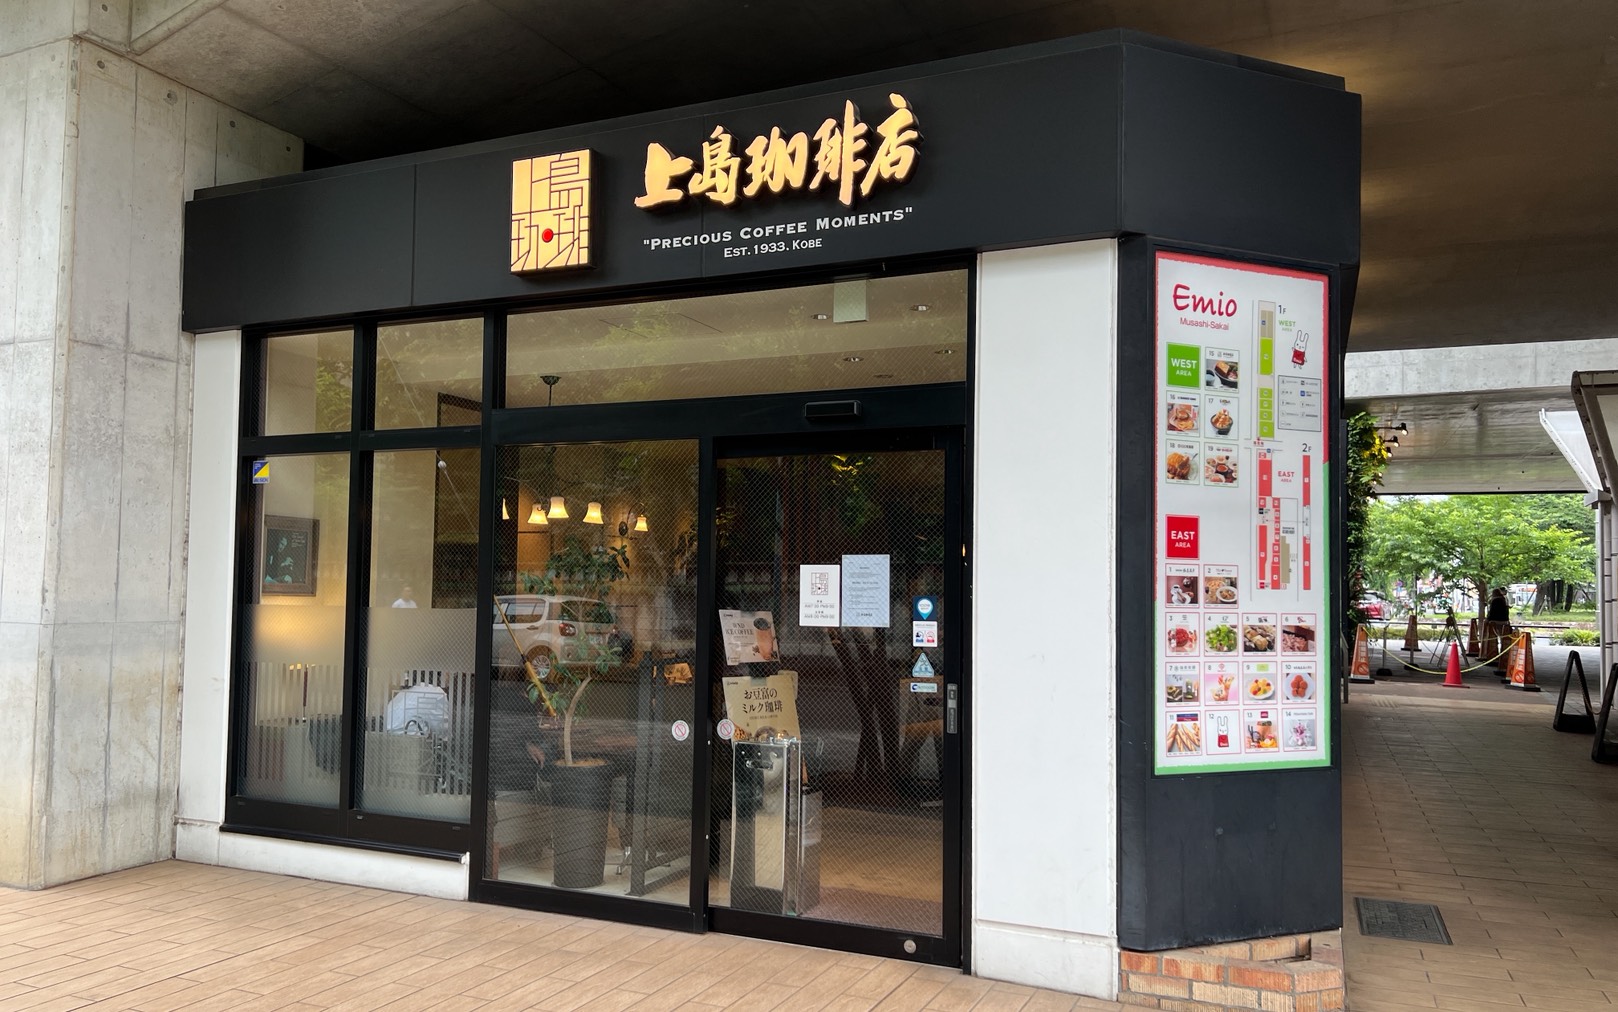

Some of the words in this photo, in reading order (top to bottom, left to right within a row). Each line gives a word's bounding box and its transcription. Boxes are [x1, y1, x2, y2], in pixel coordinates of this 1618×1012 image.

[634, 92, 919, 207] 上島珈琲店
[739, 221, 808, 240] COFFEE
[1172, 283, 1238, 318] Emio
[1179, 317, 1230, 331] Musashi-Sakai
[1278, 319, 1297, 327] WEST
[1170, 357, 1198, 370] WEST
[1175, 369, 1192, 377] AREA
[1277, 470, 1295, 478] EAST
[1170, 530, 1196, 541] EAST
[1174, 541, 1192, 549] AREA
